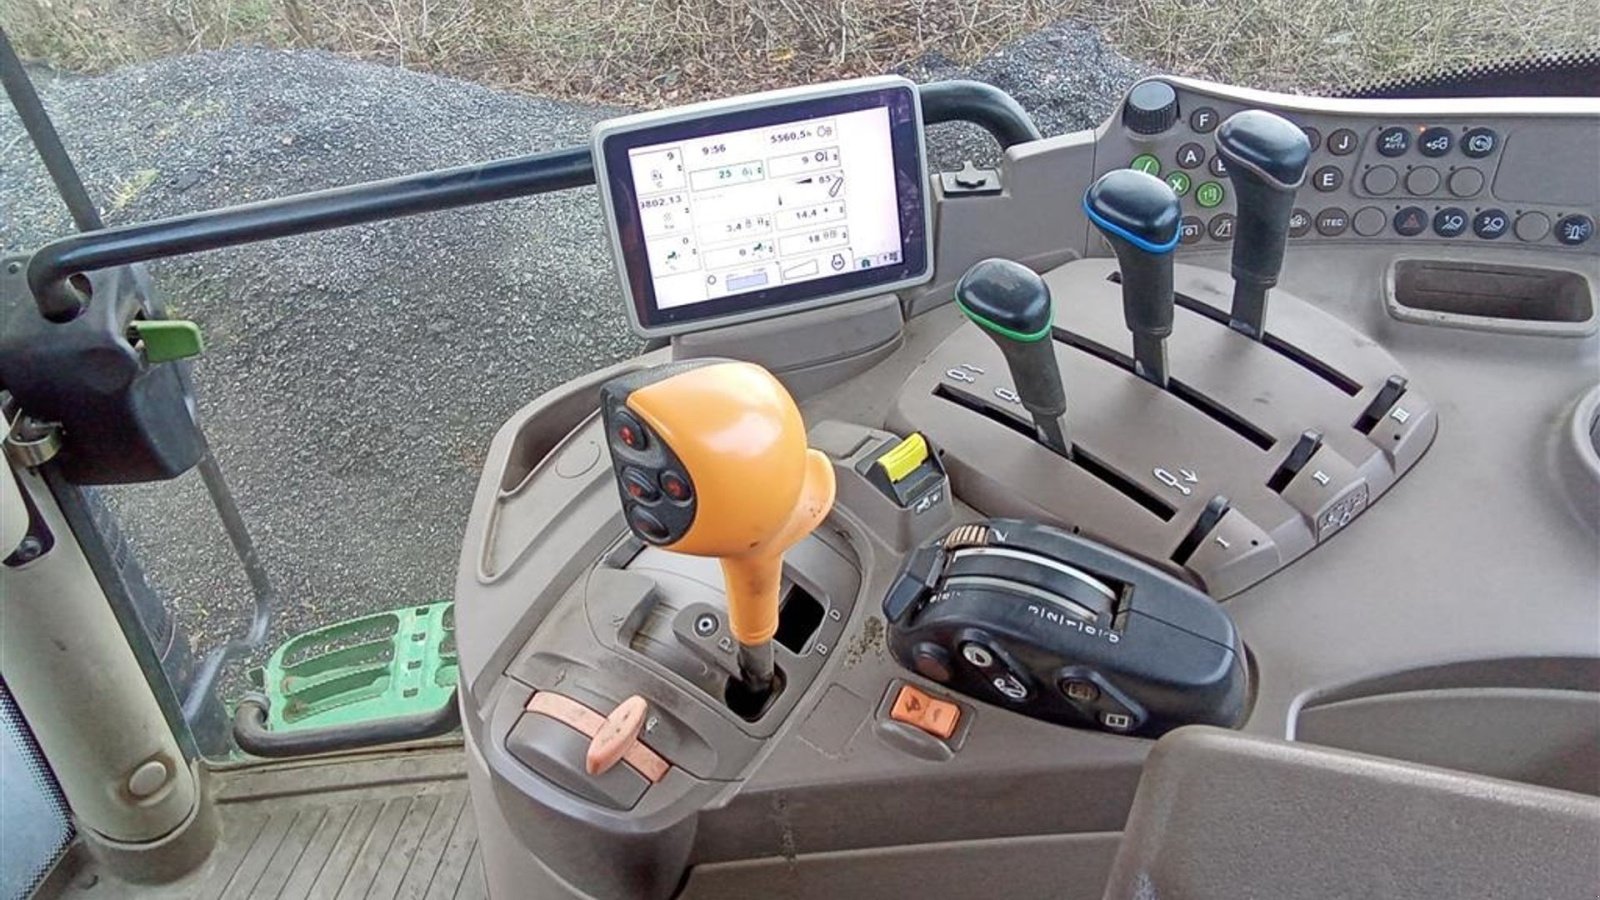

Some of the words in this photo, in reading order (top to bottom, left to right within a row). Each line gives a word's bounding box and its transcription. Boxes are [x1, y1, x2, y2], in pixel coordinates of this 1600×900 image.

[1199, 113, 1209, 127] F
[1338, 136, 1349, 150] J
[666, 151, 675, 161] 9
[701, 145, 727, 156] 9:56
[1185, 150, 1197, 164] A
[718, 169, 733, 180] 25
[1322, 172, 1334, 186] E
[1313, 470, 1330, 485] II
[829, 608, 841, 621] D
[816, 643, 828, 655] B
